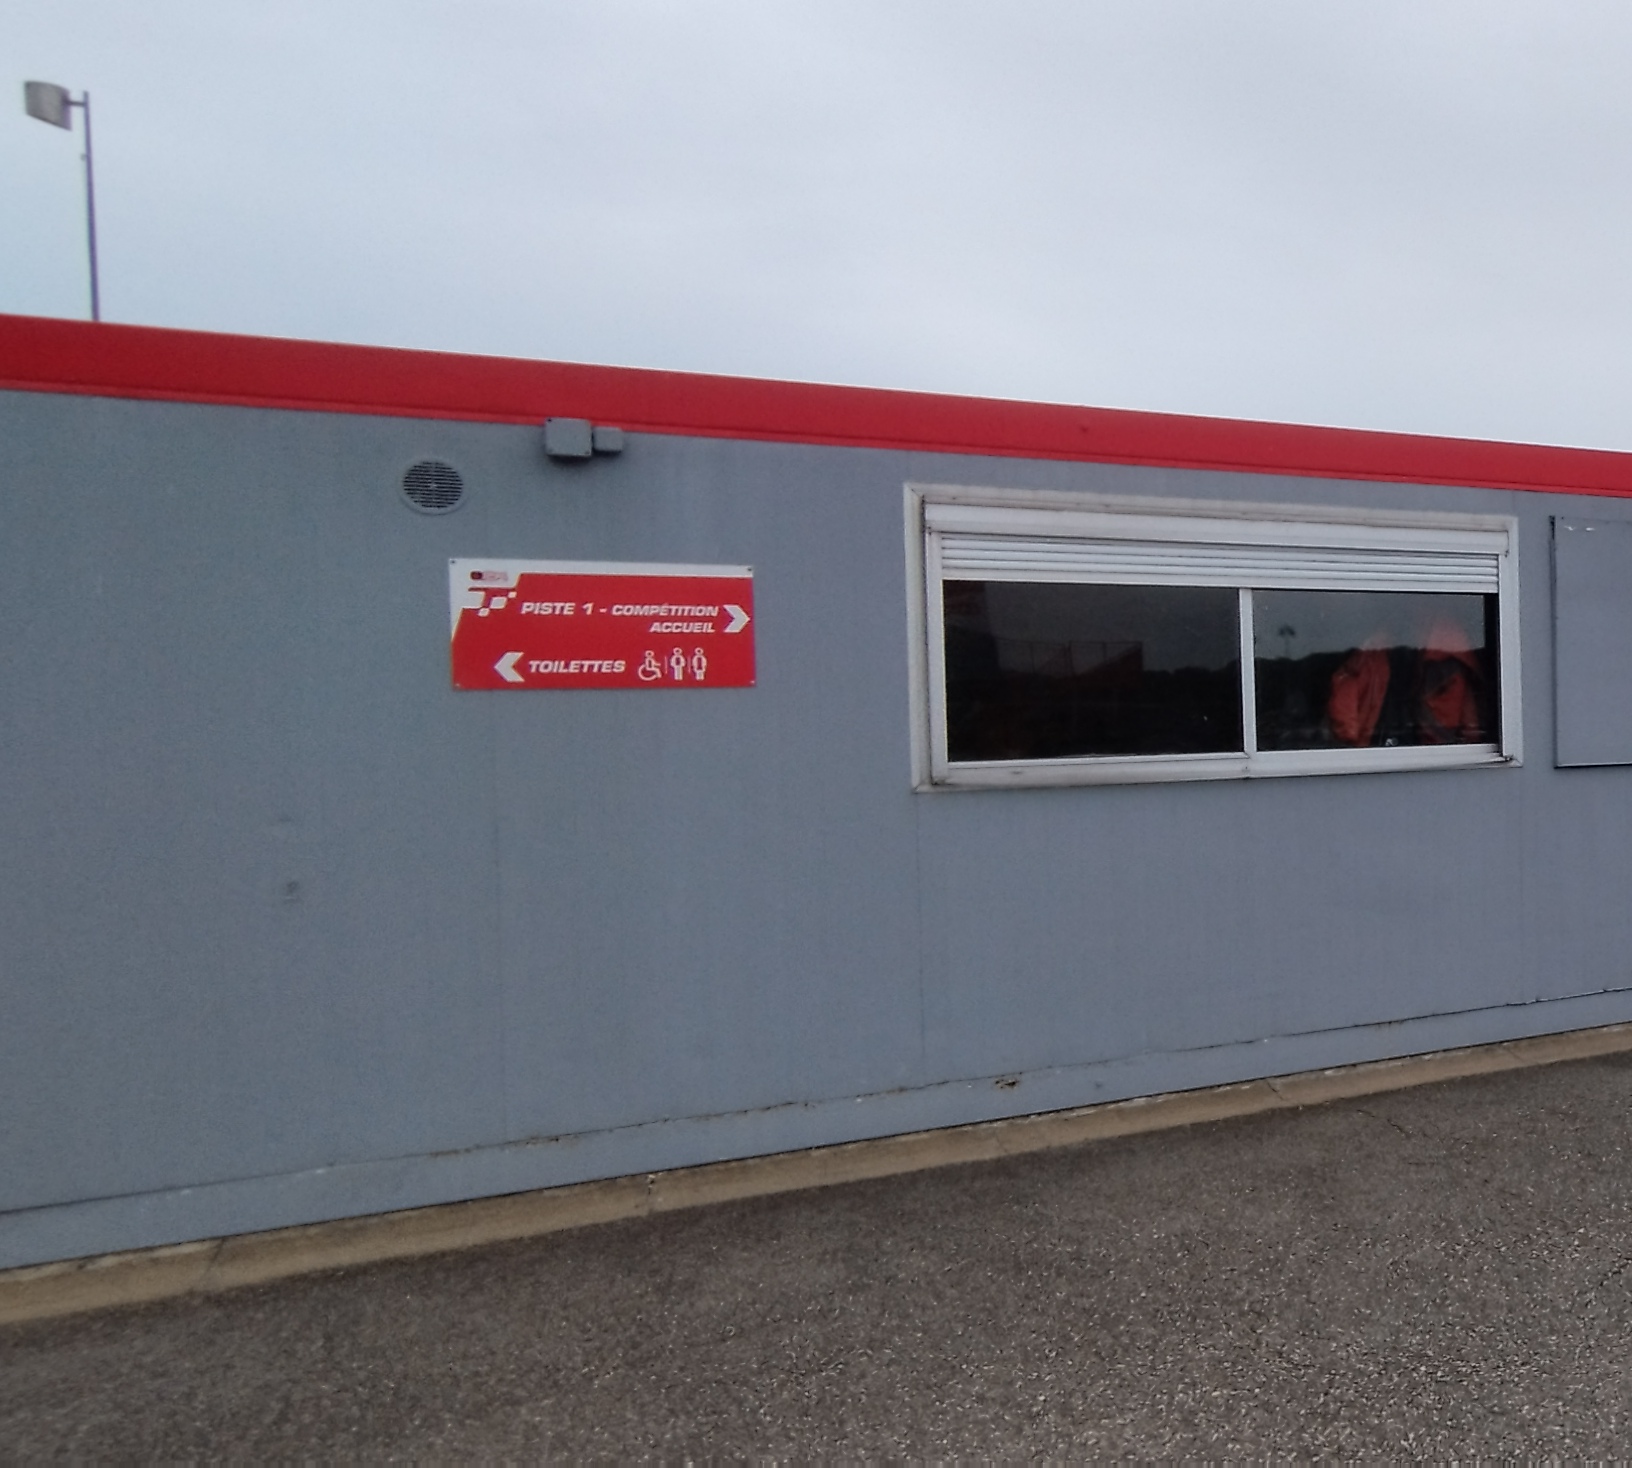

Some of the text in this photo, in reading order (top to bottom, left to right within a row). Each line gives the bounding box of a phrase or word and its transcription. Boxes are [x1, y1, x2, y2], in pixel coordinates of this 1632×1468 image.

[520, 602, 576, 616] PISTE
[581, 602, 594, 615] 1
[649, 622, 716, 633] ACCUEIL
[529, 660, 627, 674] TOILETTES
